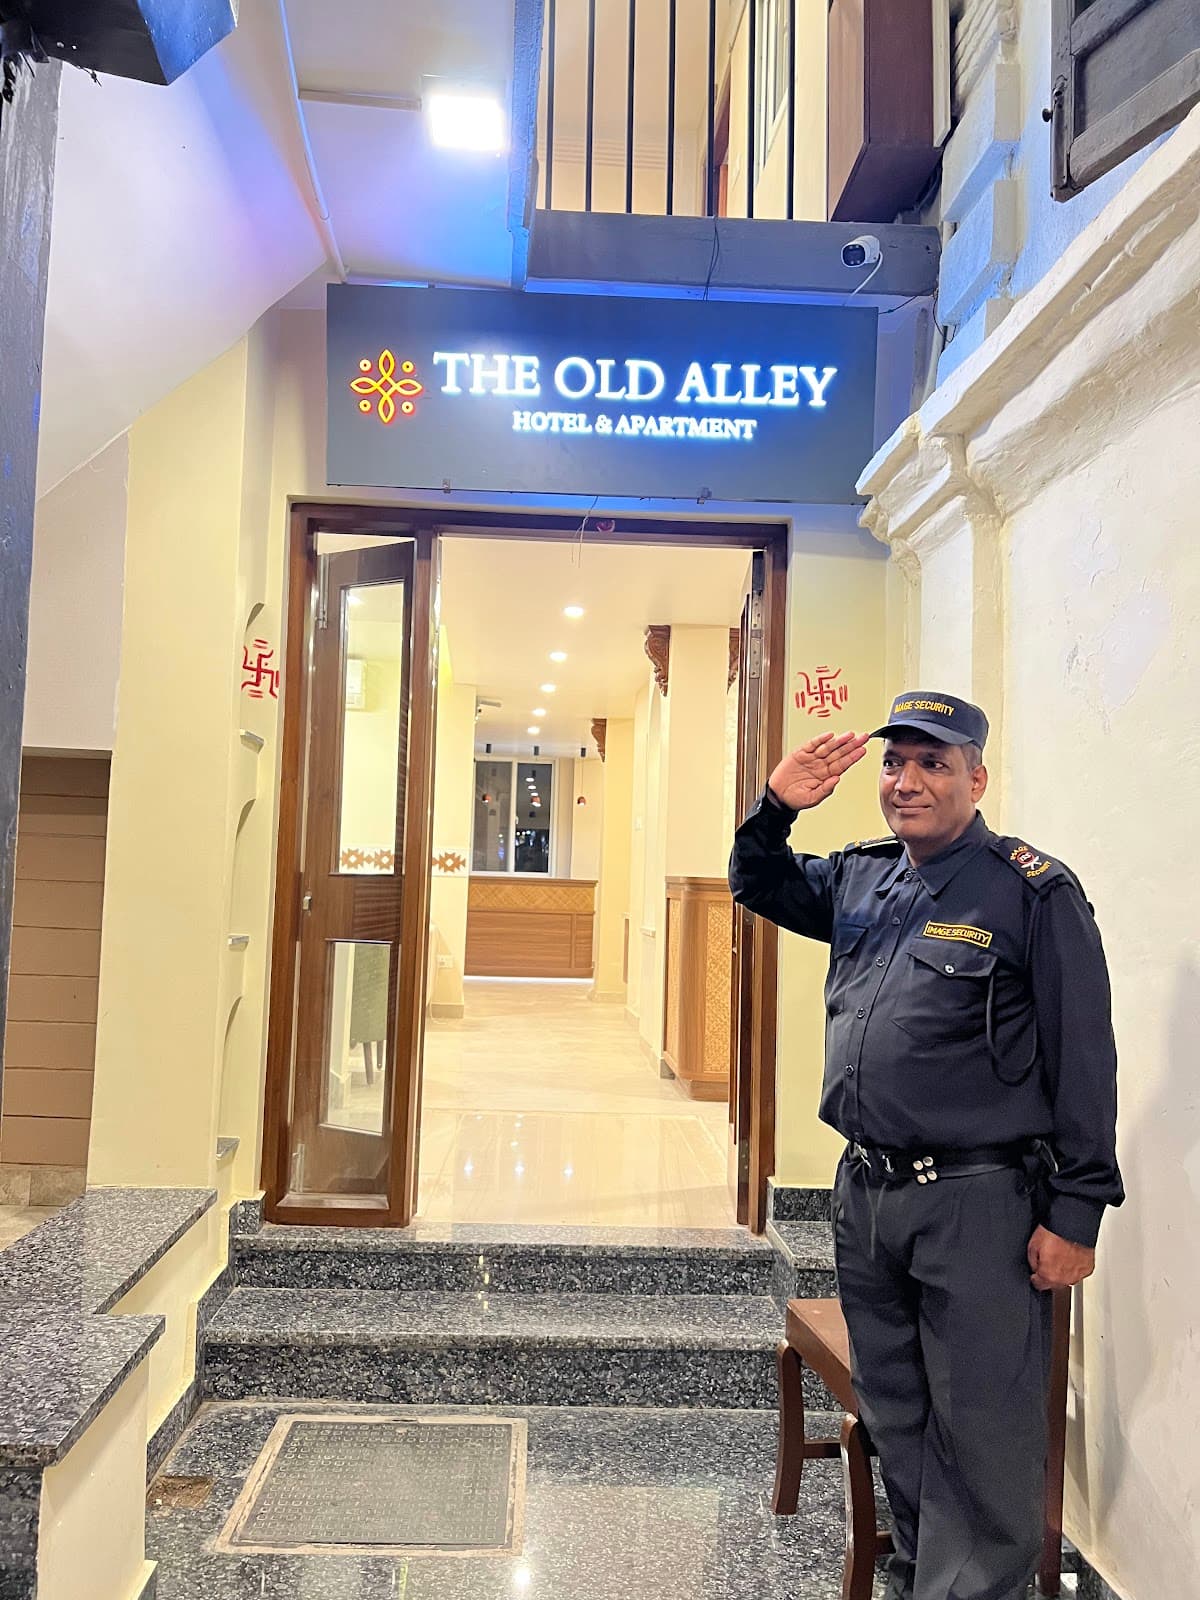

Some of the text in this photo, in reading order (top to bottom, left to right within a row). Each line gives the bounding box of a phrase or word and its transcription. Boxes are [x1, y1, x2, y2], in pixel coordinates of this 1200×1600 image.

[433, 351, 838, 407] THE OLD ALLEY
[511, 410, 758, 440] HOTEL & APARTMENT
[914, 700, 955, 716] SECURITY
